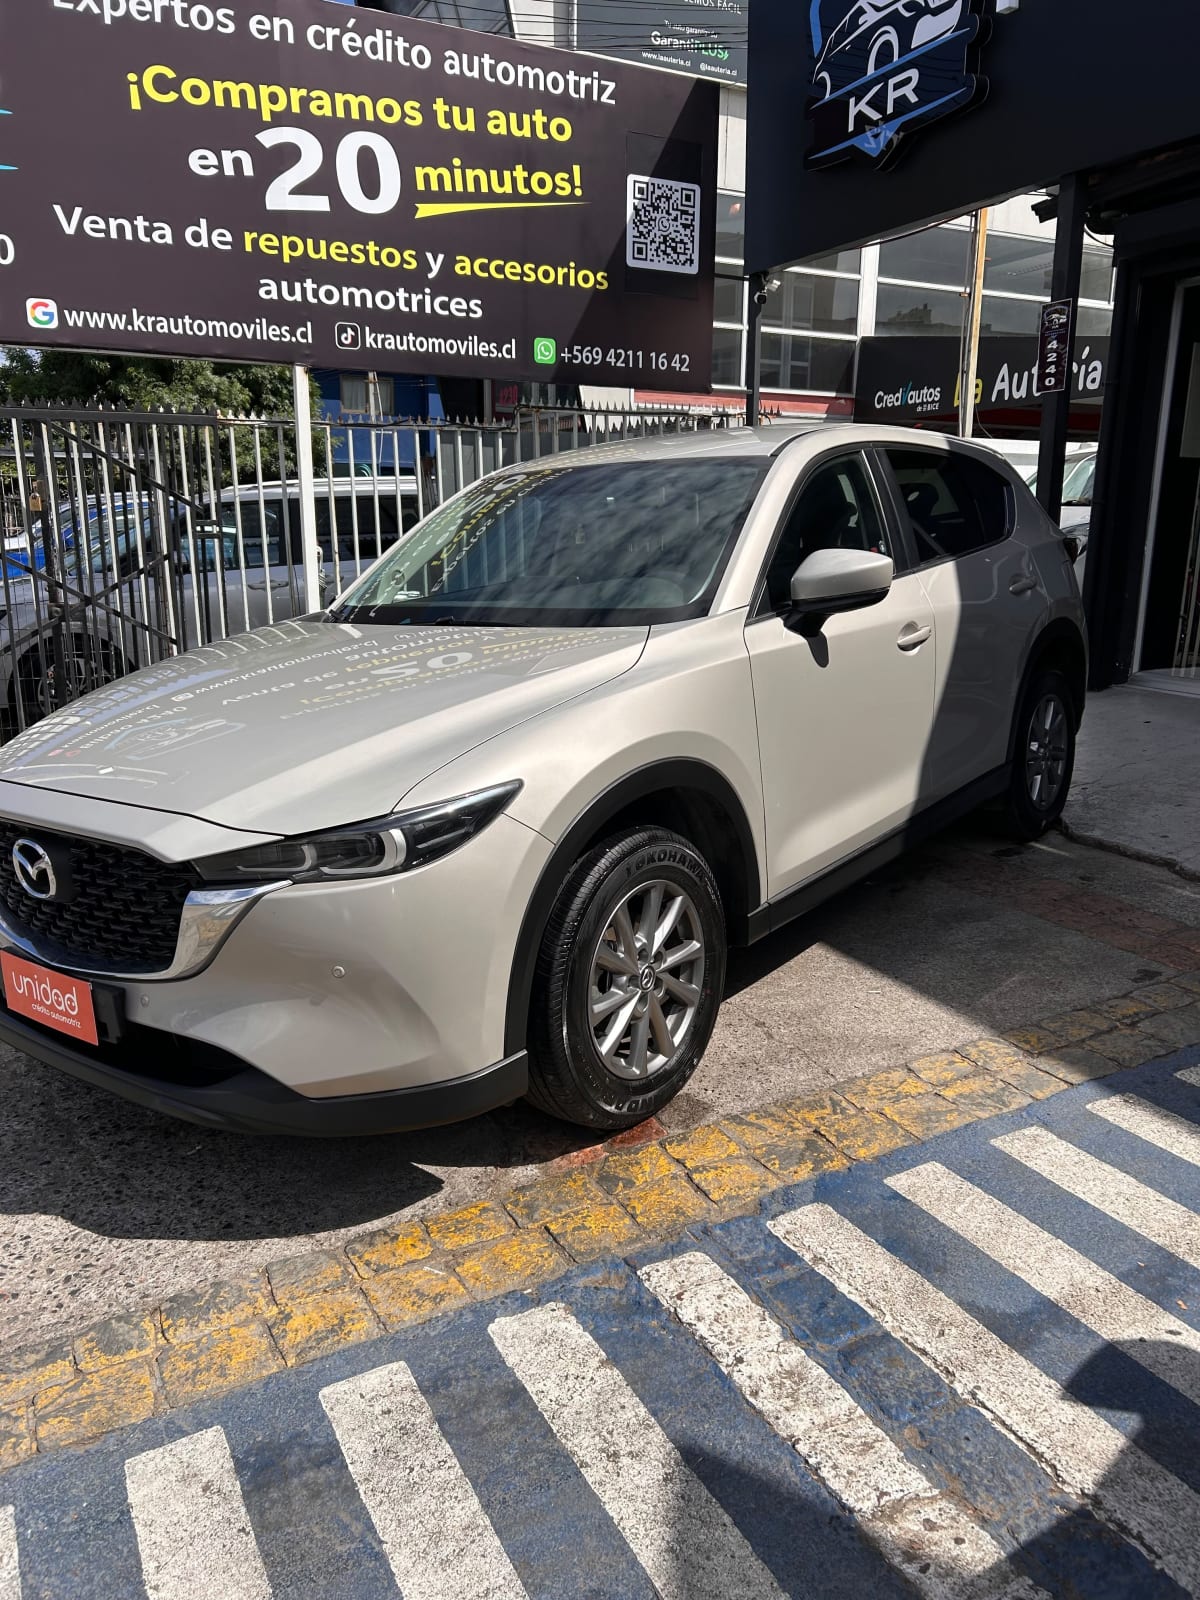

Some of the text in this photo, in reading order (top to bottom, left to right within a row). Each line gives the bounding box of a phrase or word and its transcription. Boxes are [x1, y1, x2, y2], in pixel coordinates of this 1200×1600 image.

[54, 0, 617, 106] Expertos en crédito automotriz
[126, 65, 573, 142] ¡Compramos tu auto
[848, 68, 919, 133] KR
[188, 126, 583, 214] en 20 minutos!
[53, 204, 609, 291] Venta de repuestos y accesorios
[258, 277, 484, 319] automotrices
[64, 308, 313, 344] www.krautomoviles.cl
[364, 326, 516, 360] krautomoviles.cl
[560, 344, 690, 373] +569 4211 16 42
[991, 345, 1102, 403] Autía
[1043, 338, 1060, 388] 4240
[12, 971, 78, 1016] unidad
